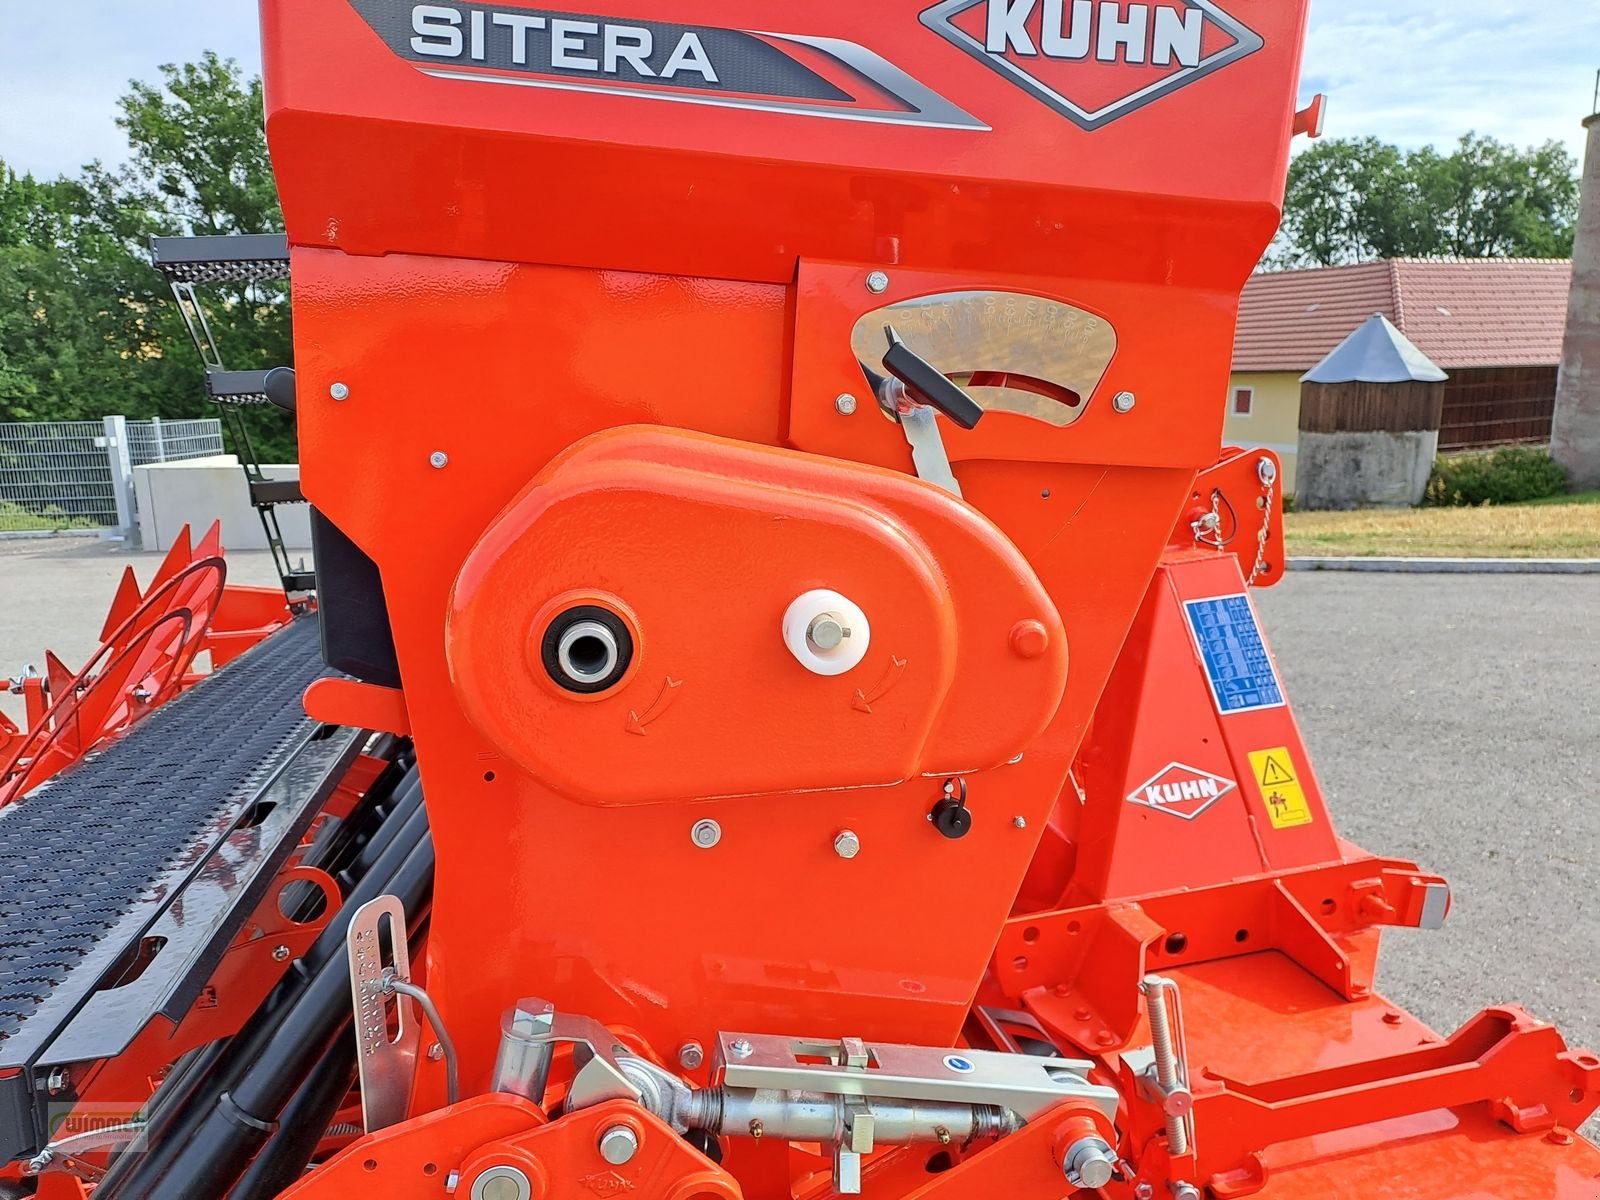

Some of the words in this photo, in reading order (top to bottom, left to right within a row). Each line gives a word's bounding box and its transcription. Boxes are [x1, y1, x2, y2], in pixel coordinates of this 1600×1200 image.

[410, 4, 720, 83] SITERA
[985, 0, 1204, 68] KUHN
[1145, 778, 1219, 806] KUHN
